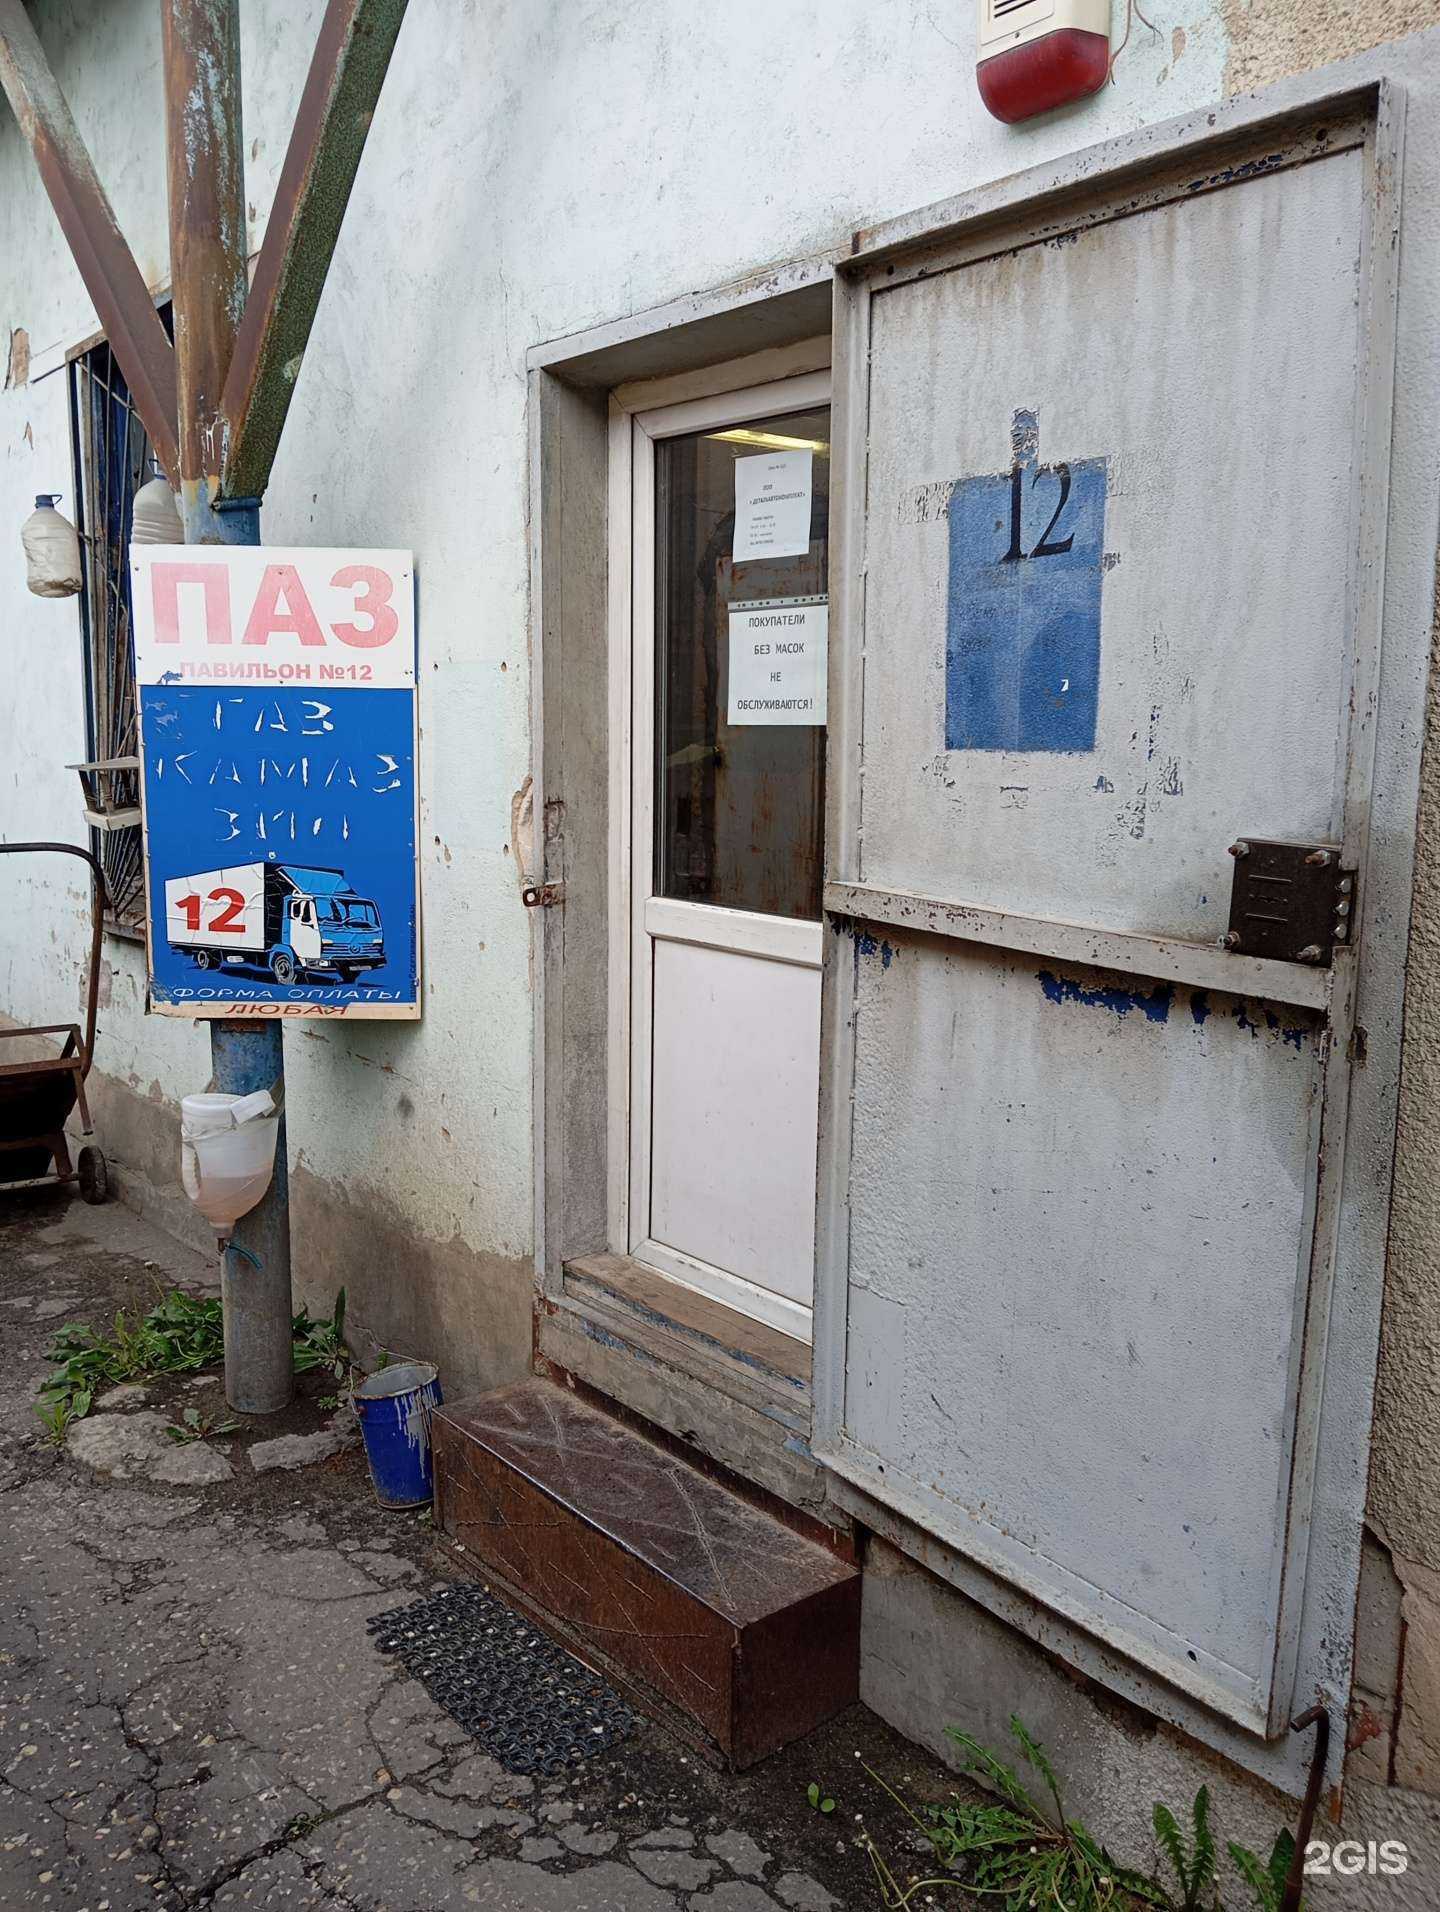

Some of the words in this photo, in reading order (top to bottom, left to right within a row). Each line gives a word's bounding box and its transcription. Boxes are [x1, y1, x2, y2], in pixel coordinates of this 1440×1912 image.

[1000, 463, 1075, 562] 12
[150, 562, 399, 649] ПАЗ
[749, 614, 805, 628] ПОКУПАТЕЛИ
[754, 644, 771, 655] БЕЗ
[775, 642, 805, 654] МАСОК
[180, 661, 311, 681] ПАВИЛЬОН
[319, 664, 373, 681] №12
[770, 671, 782, 682] НЕ
[737, 699, 813, 710] ОБСЛУЖИВАЮТСЯ!
[175, 887, 246, 933] 12
[172, 987, 273, 999] ФОРМА
[287, 988, 402, 1000] ОПЛАТЫ
[223, 1003, 349, 1015] ЛЮБАЯ
